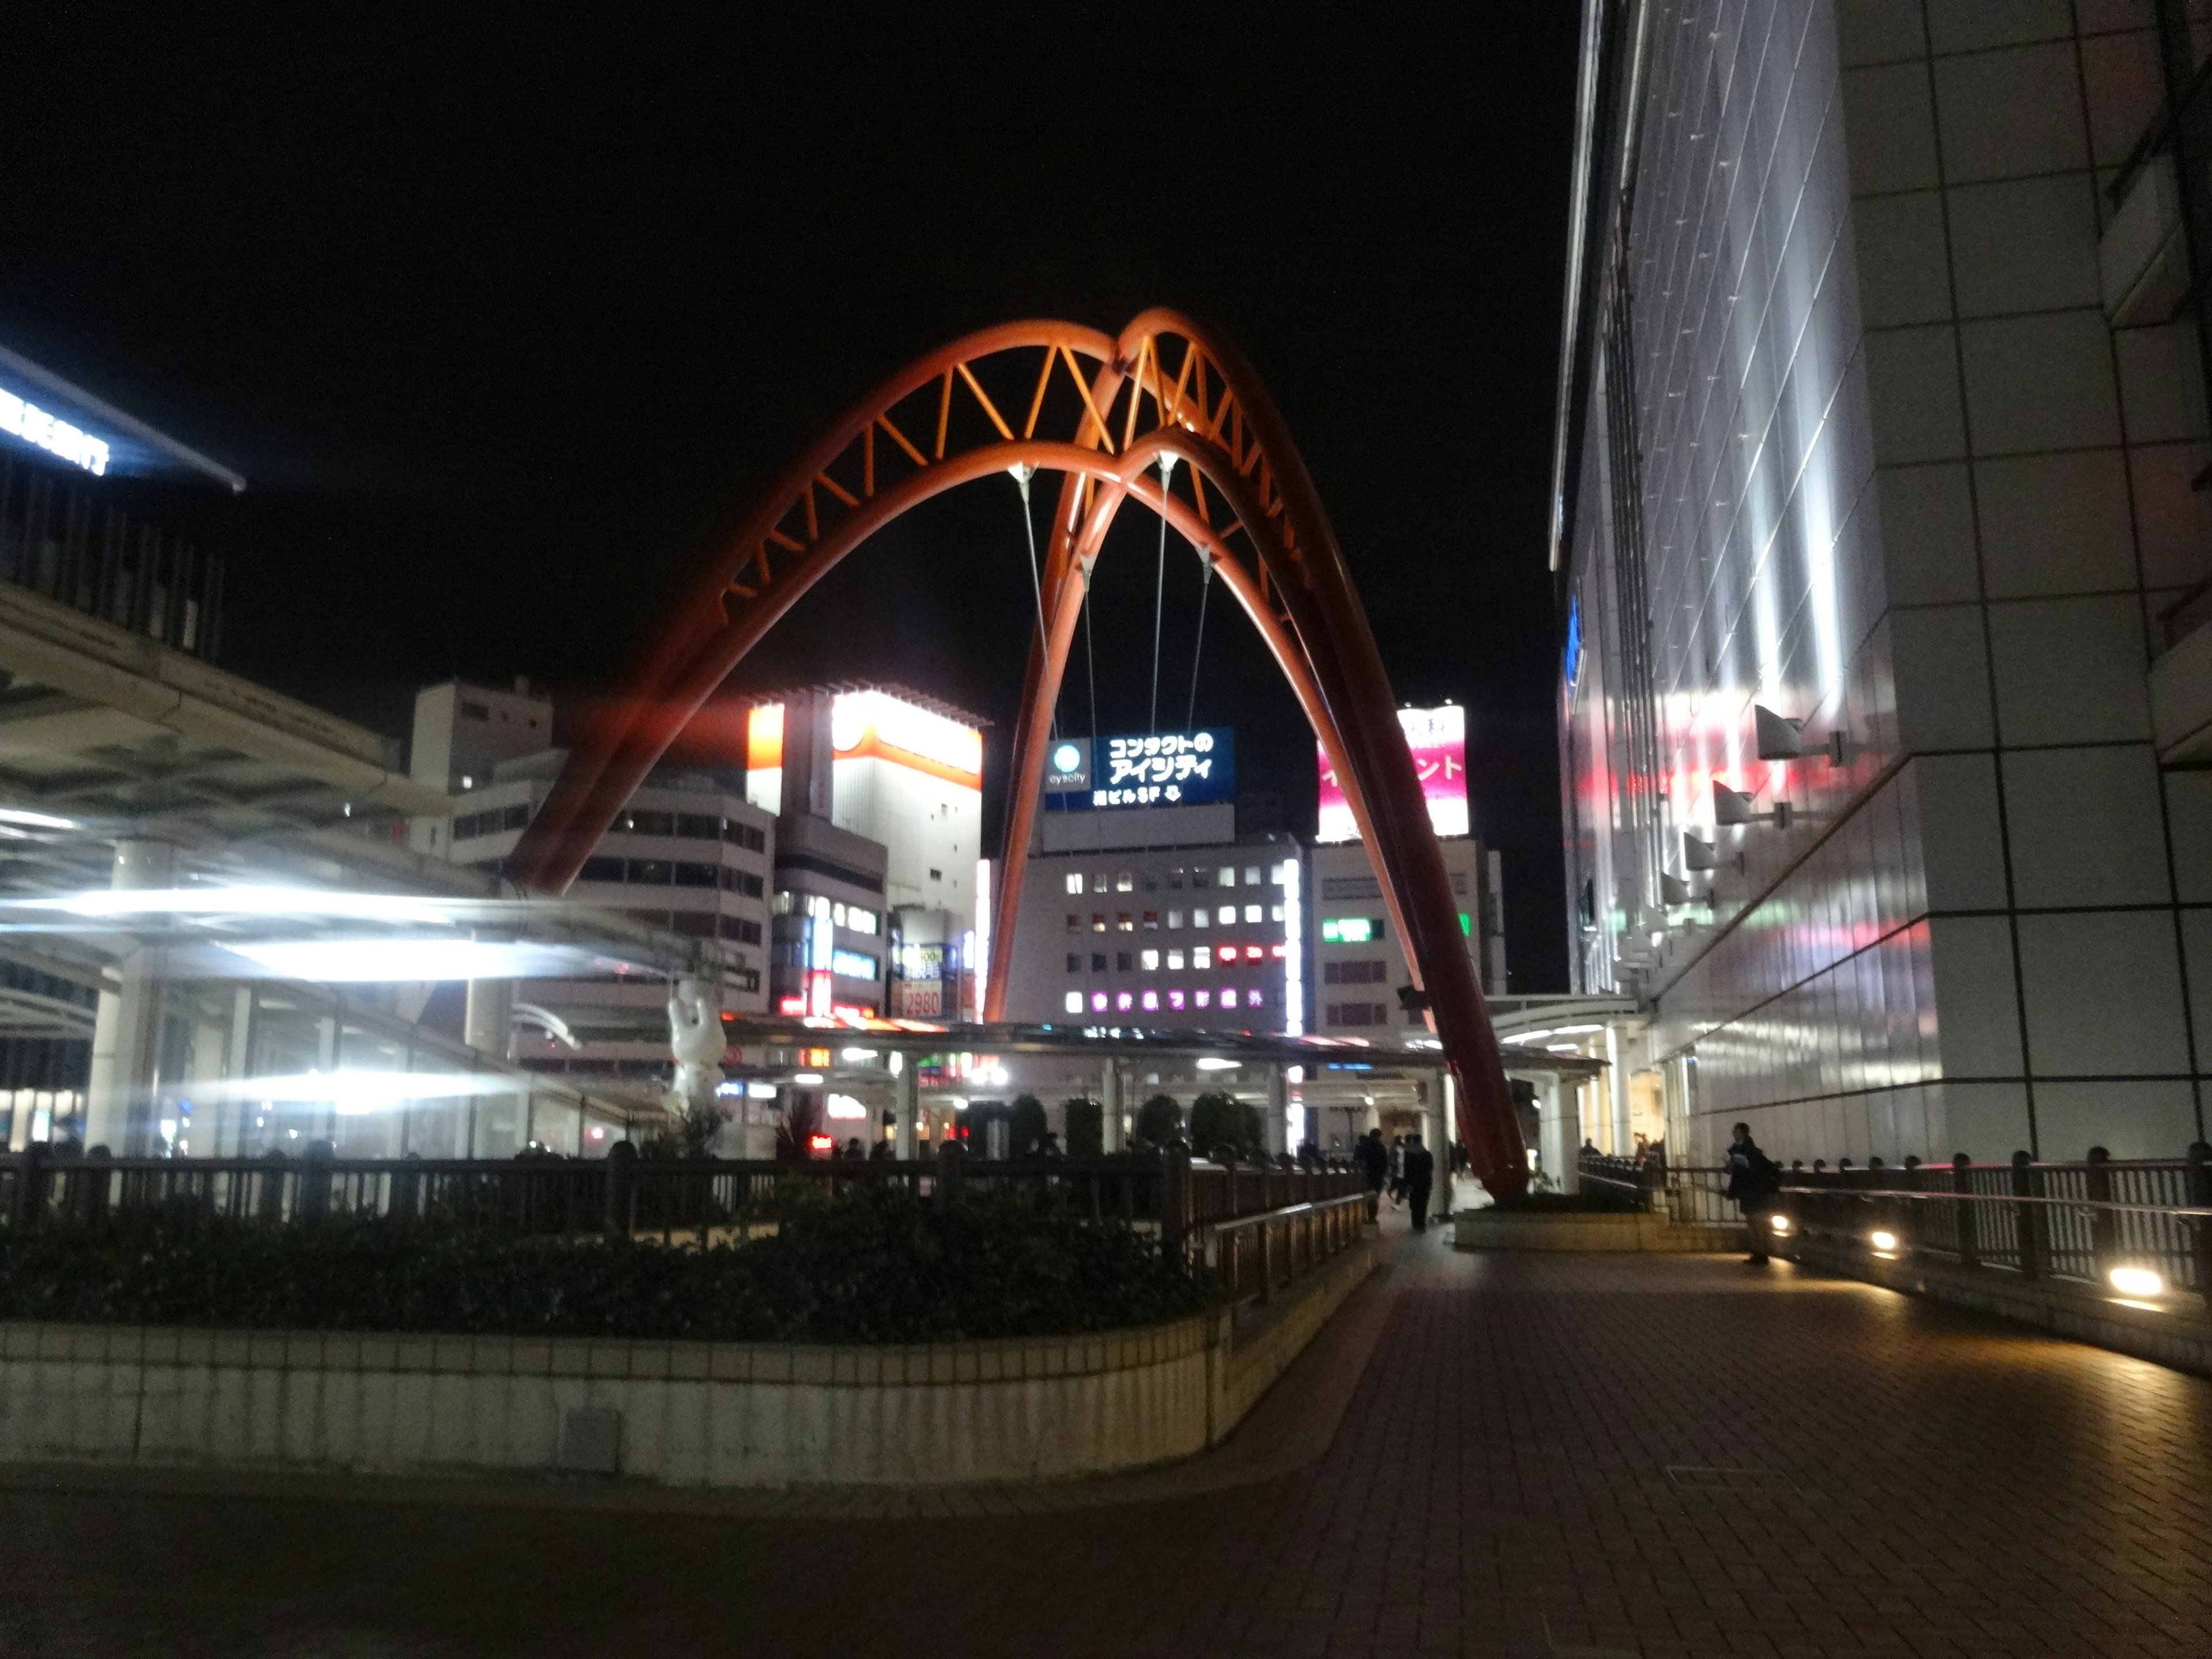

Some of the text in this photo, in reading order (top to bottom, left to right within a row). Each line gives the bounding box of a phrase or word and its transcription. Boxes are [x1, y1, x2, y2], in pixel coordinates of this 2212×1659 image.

[1109, 732, 1214, 759] コンタクトの
[1109, 755, 1212, 785] アイシティ
[906, 991, 939, 1015] 2980
